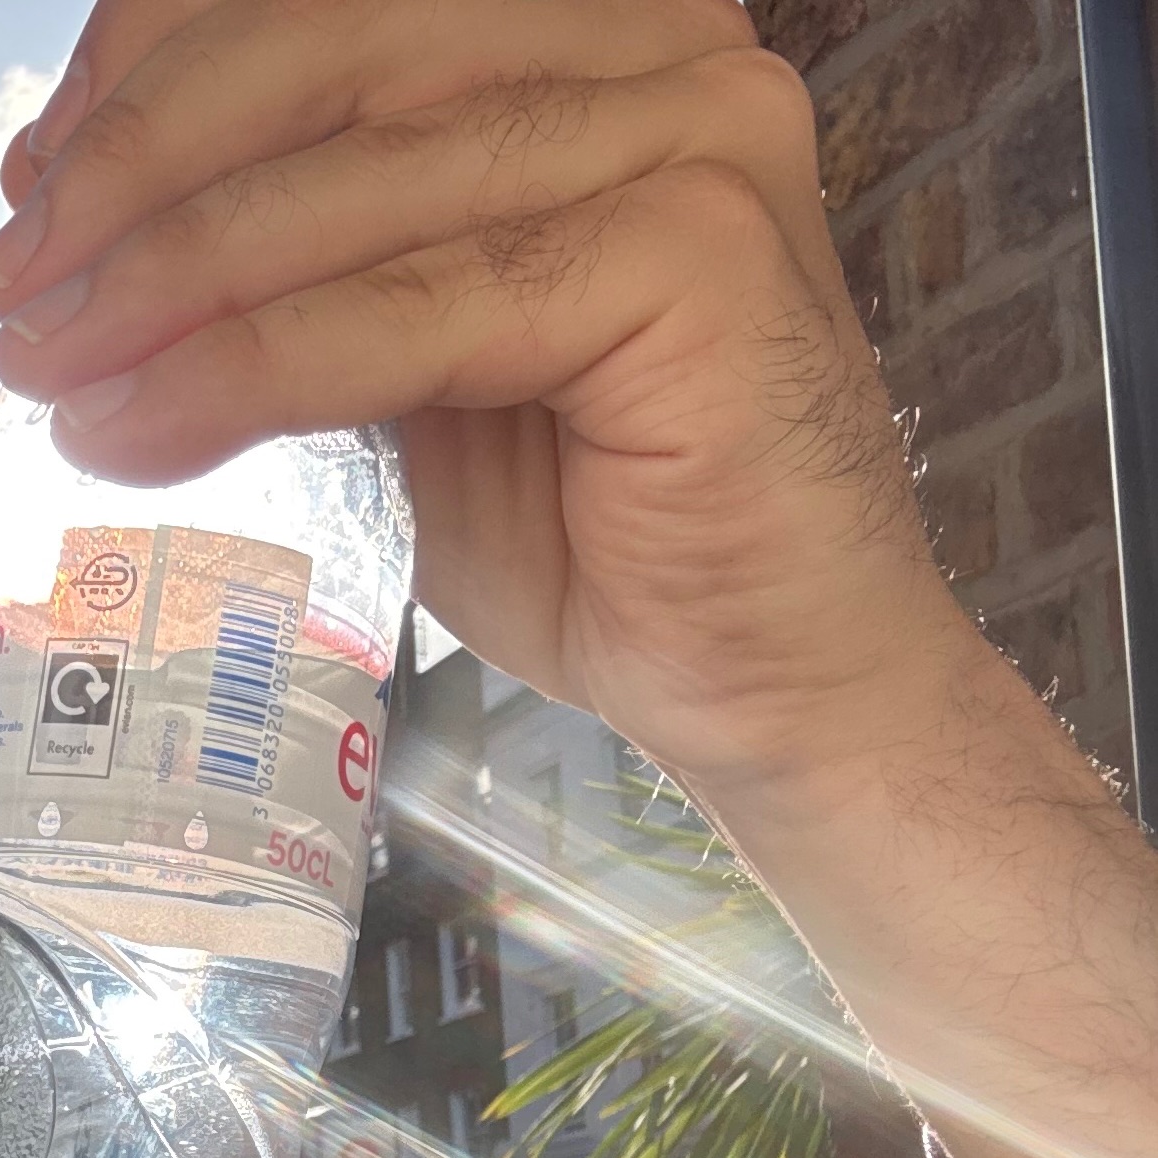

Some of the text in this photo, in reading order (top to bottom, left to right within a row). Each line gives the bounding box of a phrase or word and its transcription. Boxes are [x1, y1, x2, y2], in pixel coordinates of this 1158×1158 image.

[122, 684, 136, 735] evian.com
[46, 739, 95, 759] Recycle
[157, 719, 179, 784] 10520715
